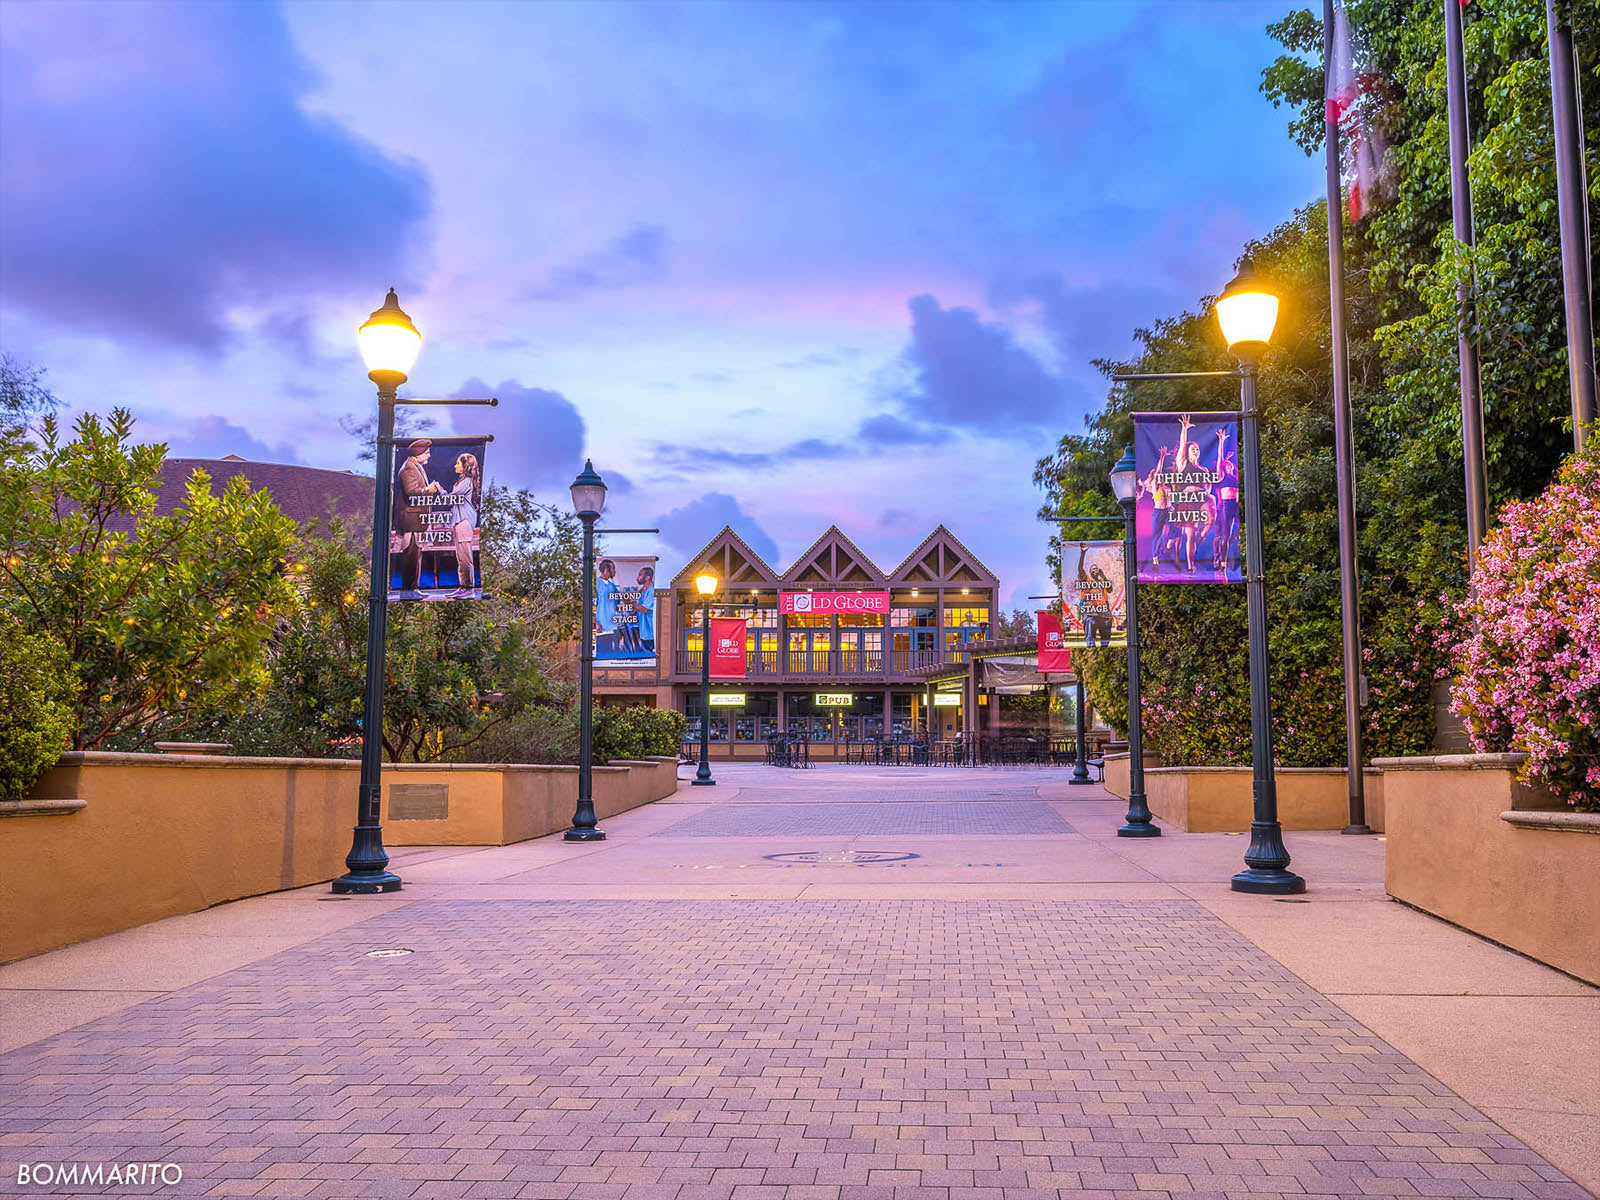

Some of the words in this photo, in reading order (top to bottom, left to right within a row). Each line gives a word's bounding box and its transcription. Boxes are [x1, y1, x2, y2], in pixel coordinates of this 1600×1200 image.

[1155, 472, 1219, 484] THEATRE
[408, 494, 465, 507] THEATRE
[1169, 491, 1206, 503] THAT
[419, 513, 452, 525] THAT
[1168, 510, 1208, 523] LIVES
[417, 531, 452, 543] LIVES
[1075, 581, 1112, 589] BEYOND
[609, 592, 641, 600] BEYOND
[1085, 593, 1103, 601] THE
[617, 603, 633, 611] THE
[834, 595, 883, 610] GLOBE
[1080, 604, 1108, 613] STAGE
[612, 615, 638, 623] STAGE
[828, 696, 849, 704] PUB
